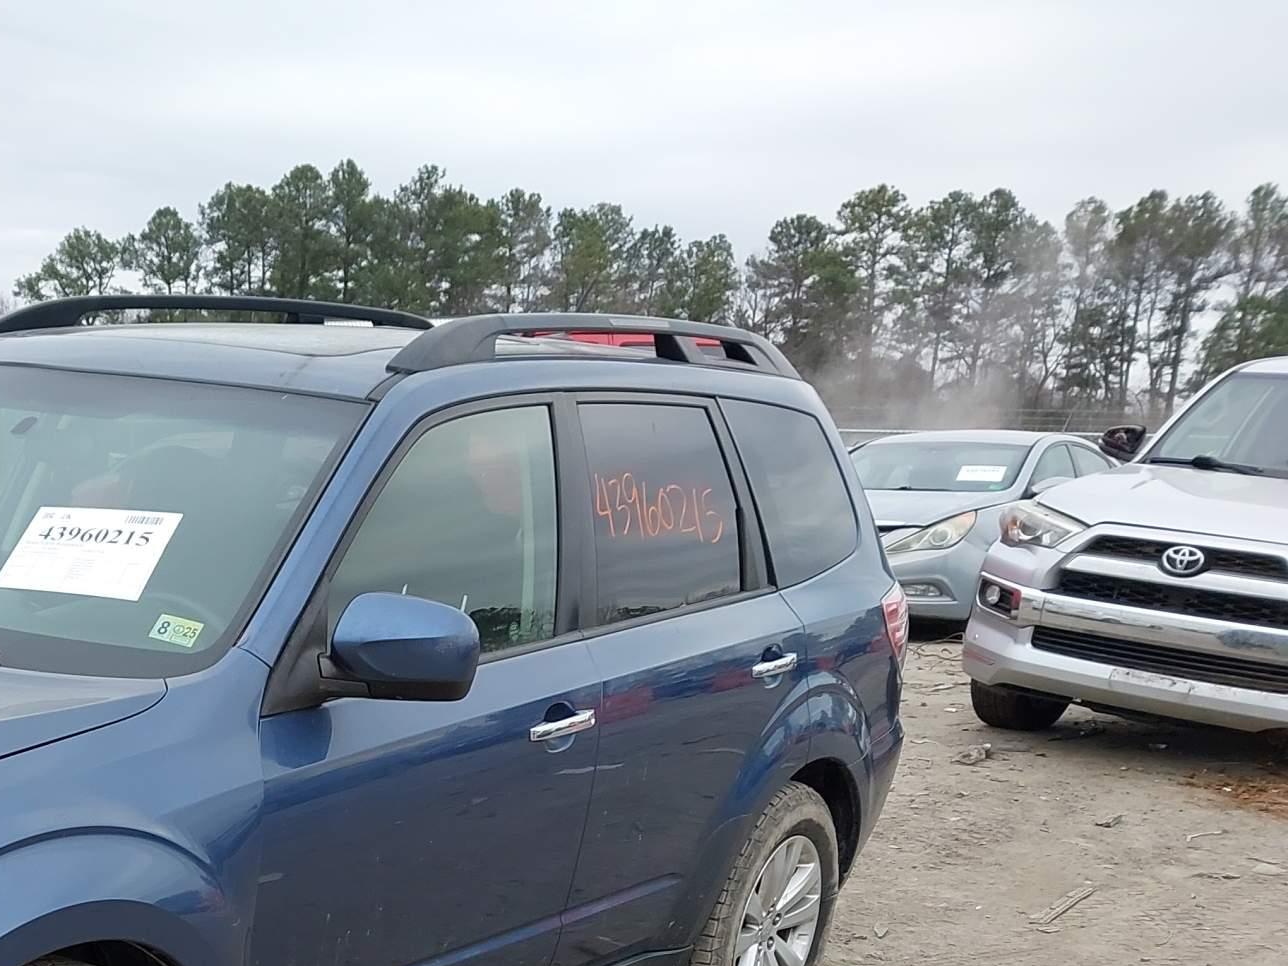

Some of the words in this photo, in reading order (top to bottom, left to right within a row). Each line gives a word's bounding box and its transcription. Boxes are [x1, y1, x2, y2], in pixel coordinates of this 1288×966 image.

[594, 473, 723, 544] 43960215
[38, 525, 154, 547] 43960215
[157, 620, 171, 635] 8
[182, 626, 198, 640] 25
